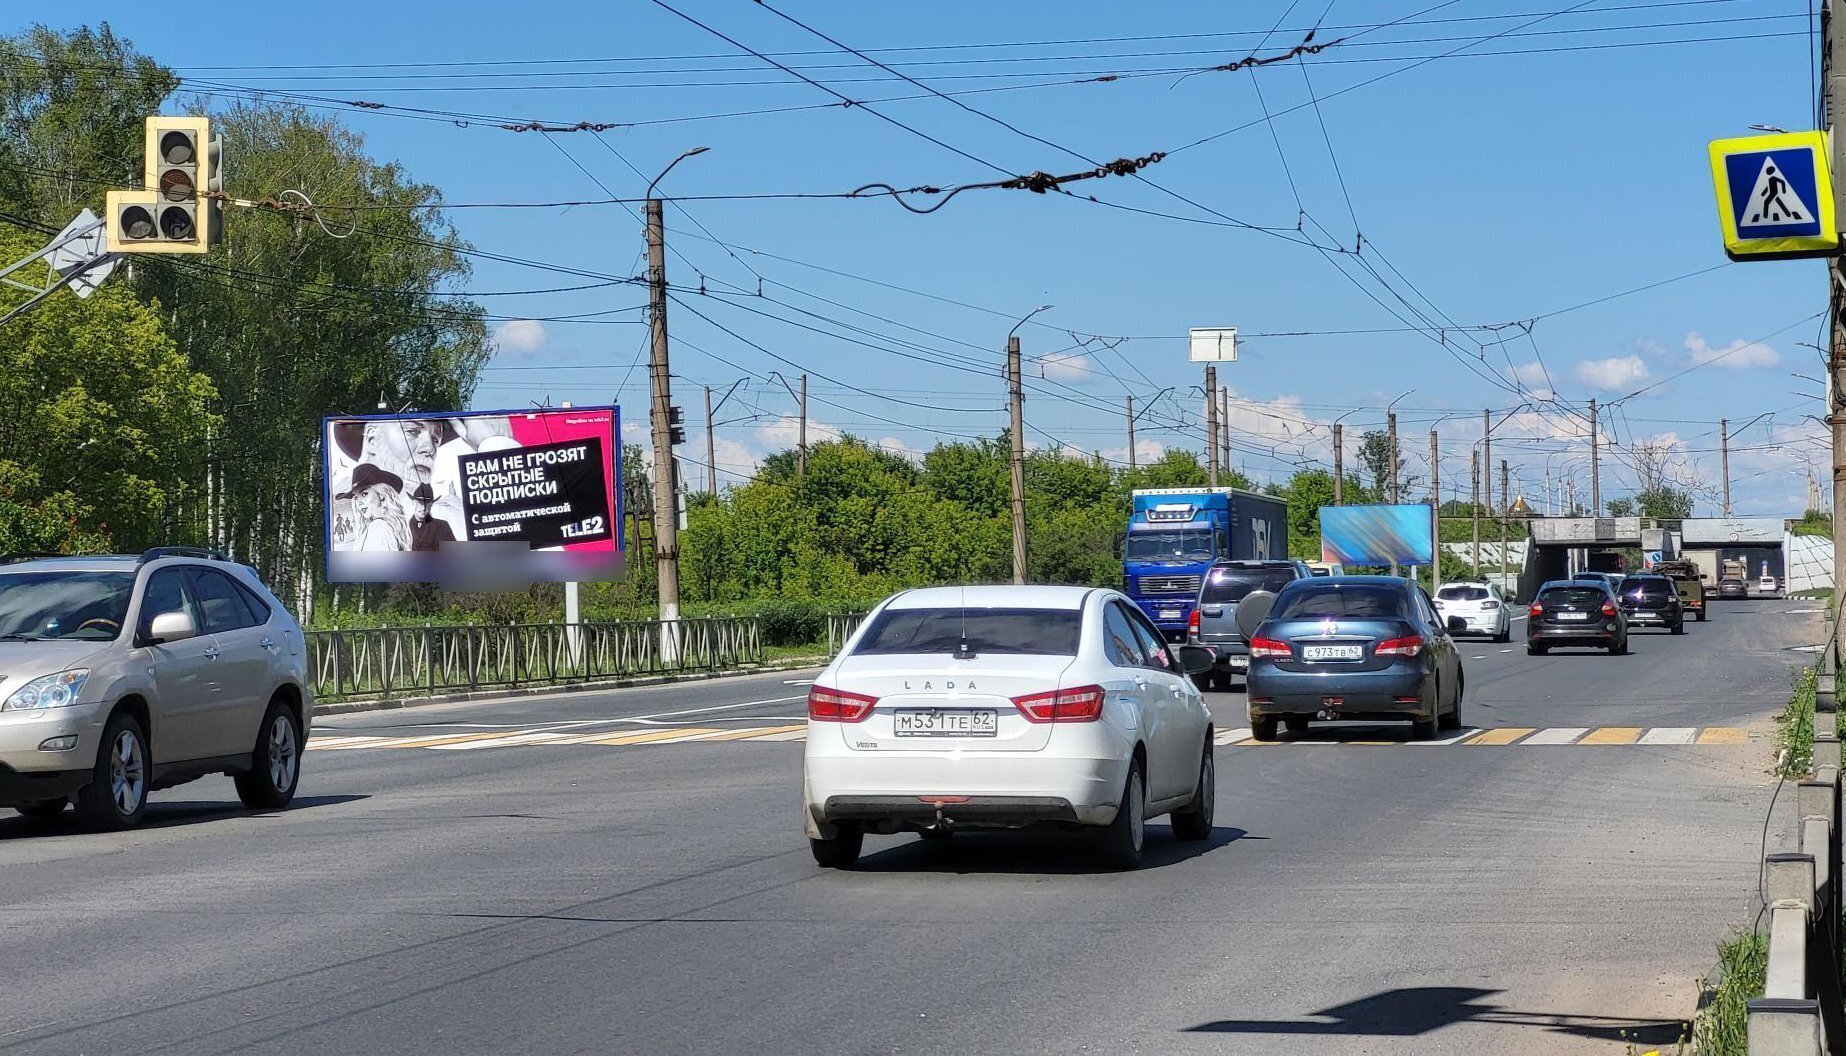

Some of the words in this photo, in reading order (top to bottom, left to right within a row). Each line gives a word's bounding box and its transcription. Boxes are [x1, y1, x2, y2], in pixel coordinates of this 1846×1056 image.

[466, 459, 499, 475] ВАМ
[502, 455, 523, 471] НЕ
[527, 446, 586, 467] ГРОЗЯТ
[467, 468, 544, 490] СКРЫТЫЕ
[469, 481, 557, 505] ПОДПИСКИ
[472, 514, 479, 524] С
[482, 503, 571, 523] автоматической
[473, 522, 521, 537] защитой
[560, 516, 604, 538] TELE2
[904, 681, 976, 690] LADA
[973, 712, 990, 725] 62
